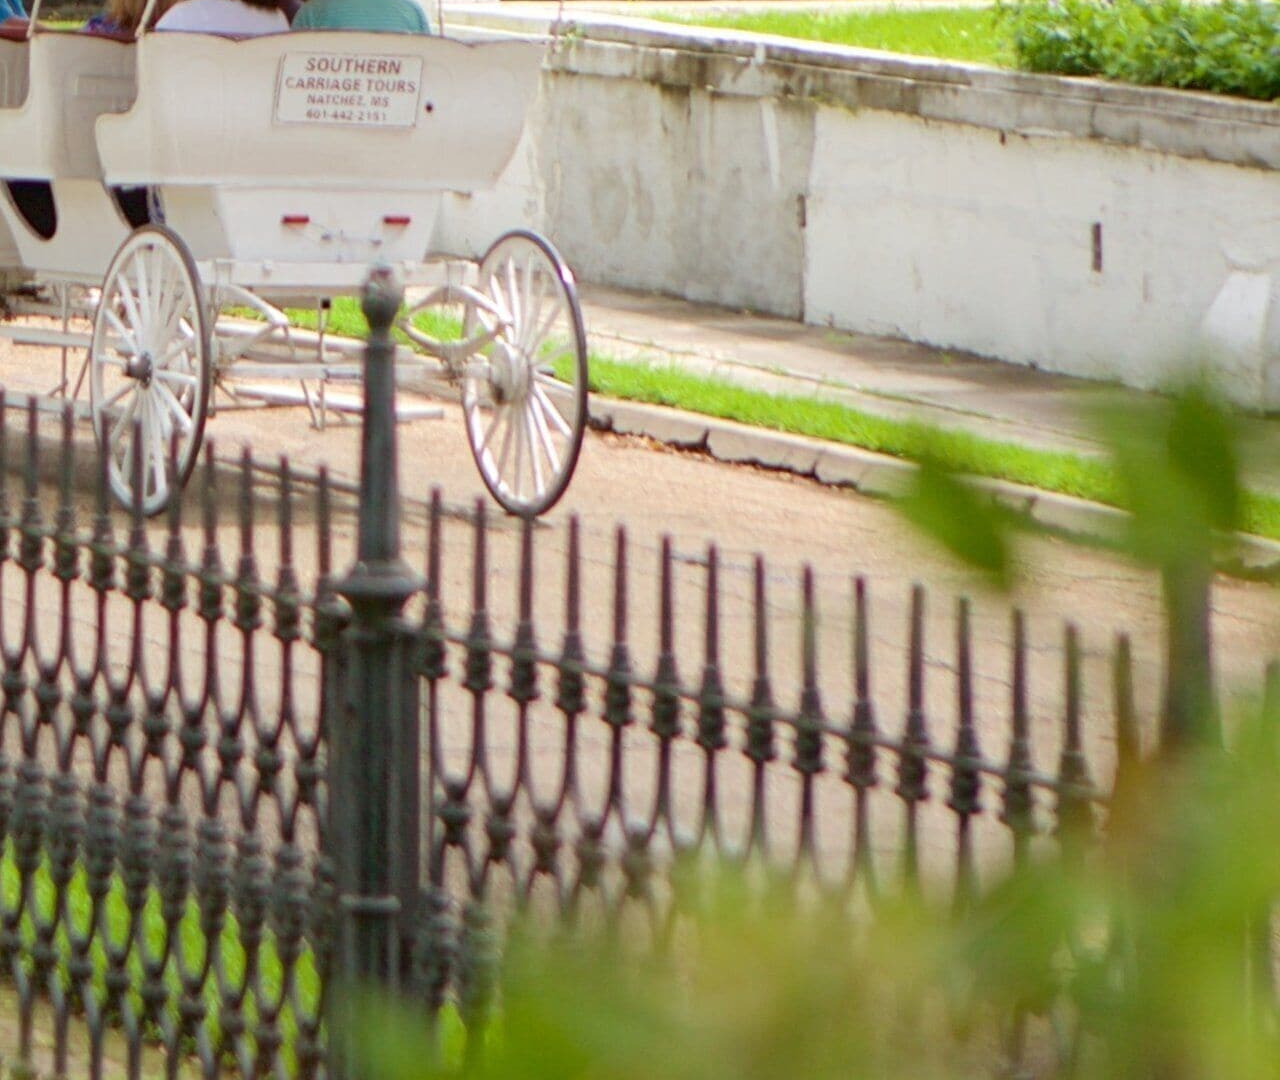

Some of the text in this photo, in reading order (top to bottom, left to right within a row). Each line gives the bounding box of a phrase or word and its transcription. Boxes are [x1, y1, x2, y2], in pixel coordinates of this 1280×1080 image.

[306, 57, 402, 75] SOUTHERN
[285, 76, 416, 93] CARRIAGE TOURS
[370, 96, 390, 108] MS
